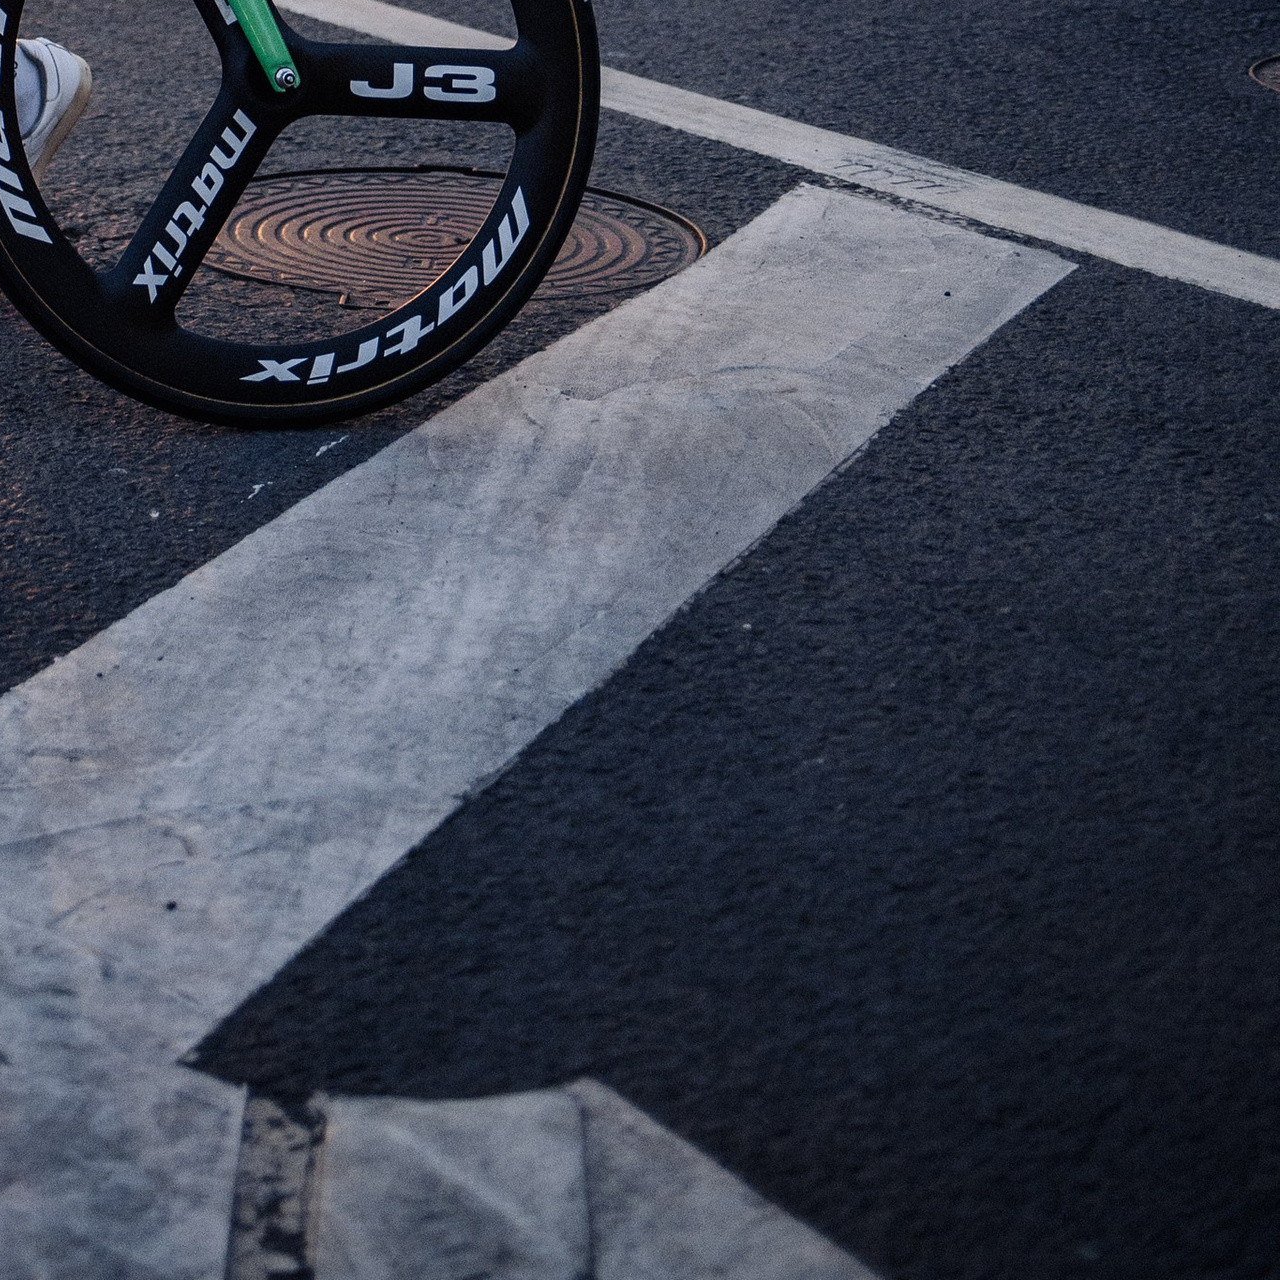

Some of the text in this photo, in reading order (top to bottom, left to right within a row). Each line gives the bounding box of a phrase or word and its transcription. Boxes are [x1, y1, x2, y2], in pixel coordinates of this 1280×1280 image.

[349, 62, 496, 103] J3
[132, 108, 258, 305] matrix
[239, 186, 530, 385] matrix
